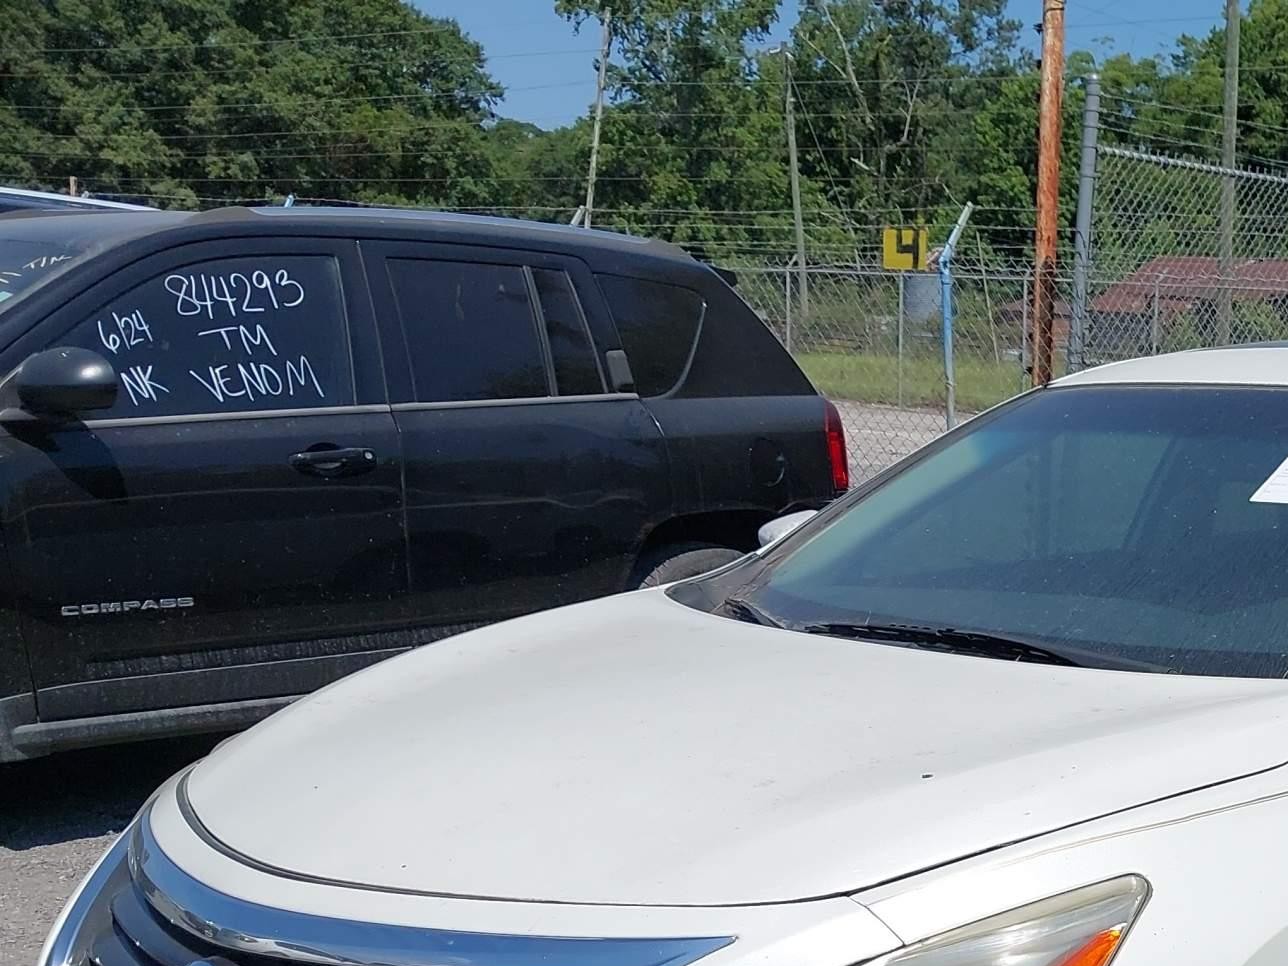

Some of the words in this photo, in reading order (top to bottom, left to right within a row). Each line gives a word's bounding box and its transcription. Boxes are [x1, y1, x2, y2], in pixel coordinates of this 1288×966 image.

[895, 228, 920, 269] 4
[164, 269, 305, 320] 844293
[97, 309, 153, 354] 6/24
[198, 324, 278, 356] TM
[120, 365, 170, 406] NK
[188, 355, 326, 402] VENOM
[61, 597, 194, 616] COMPASS
